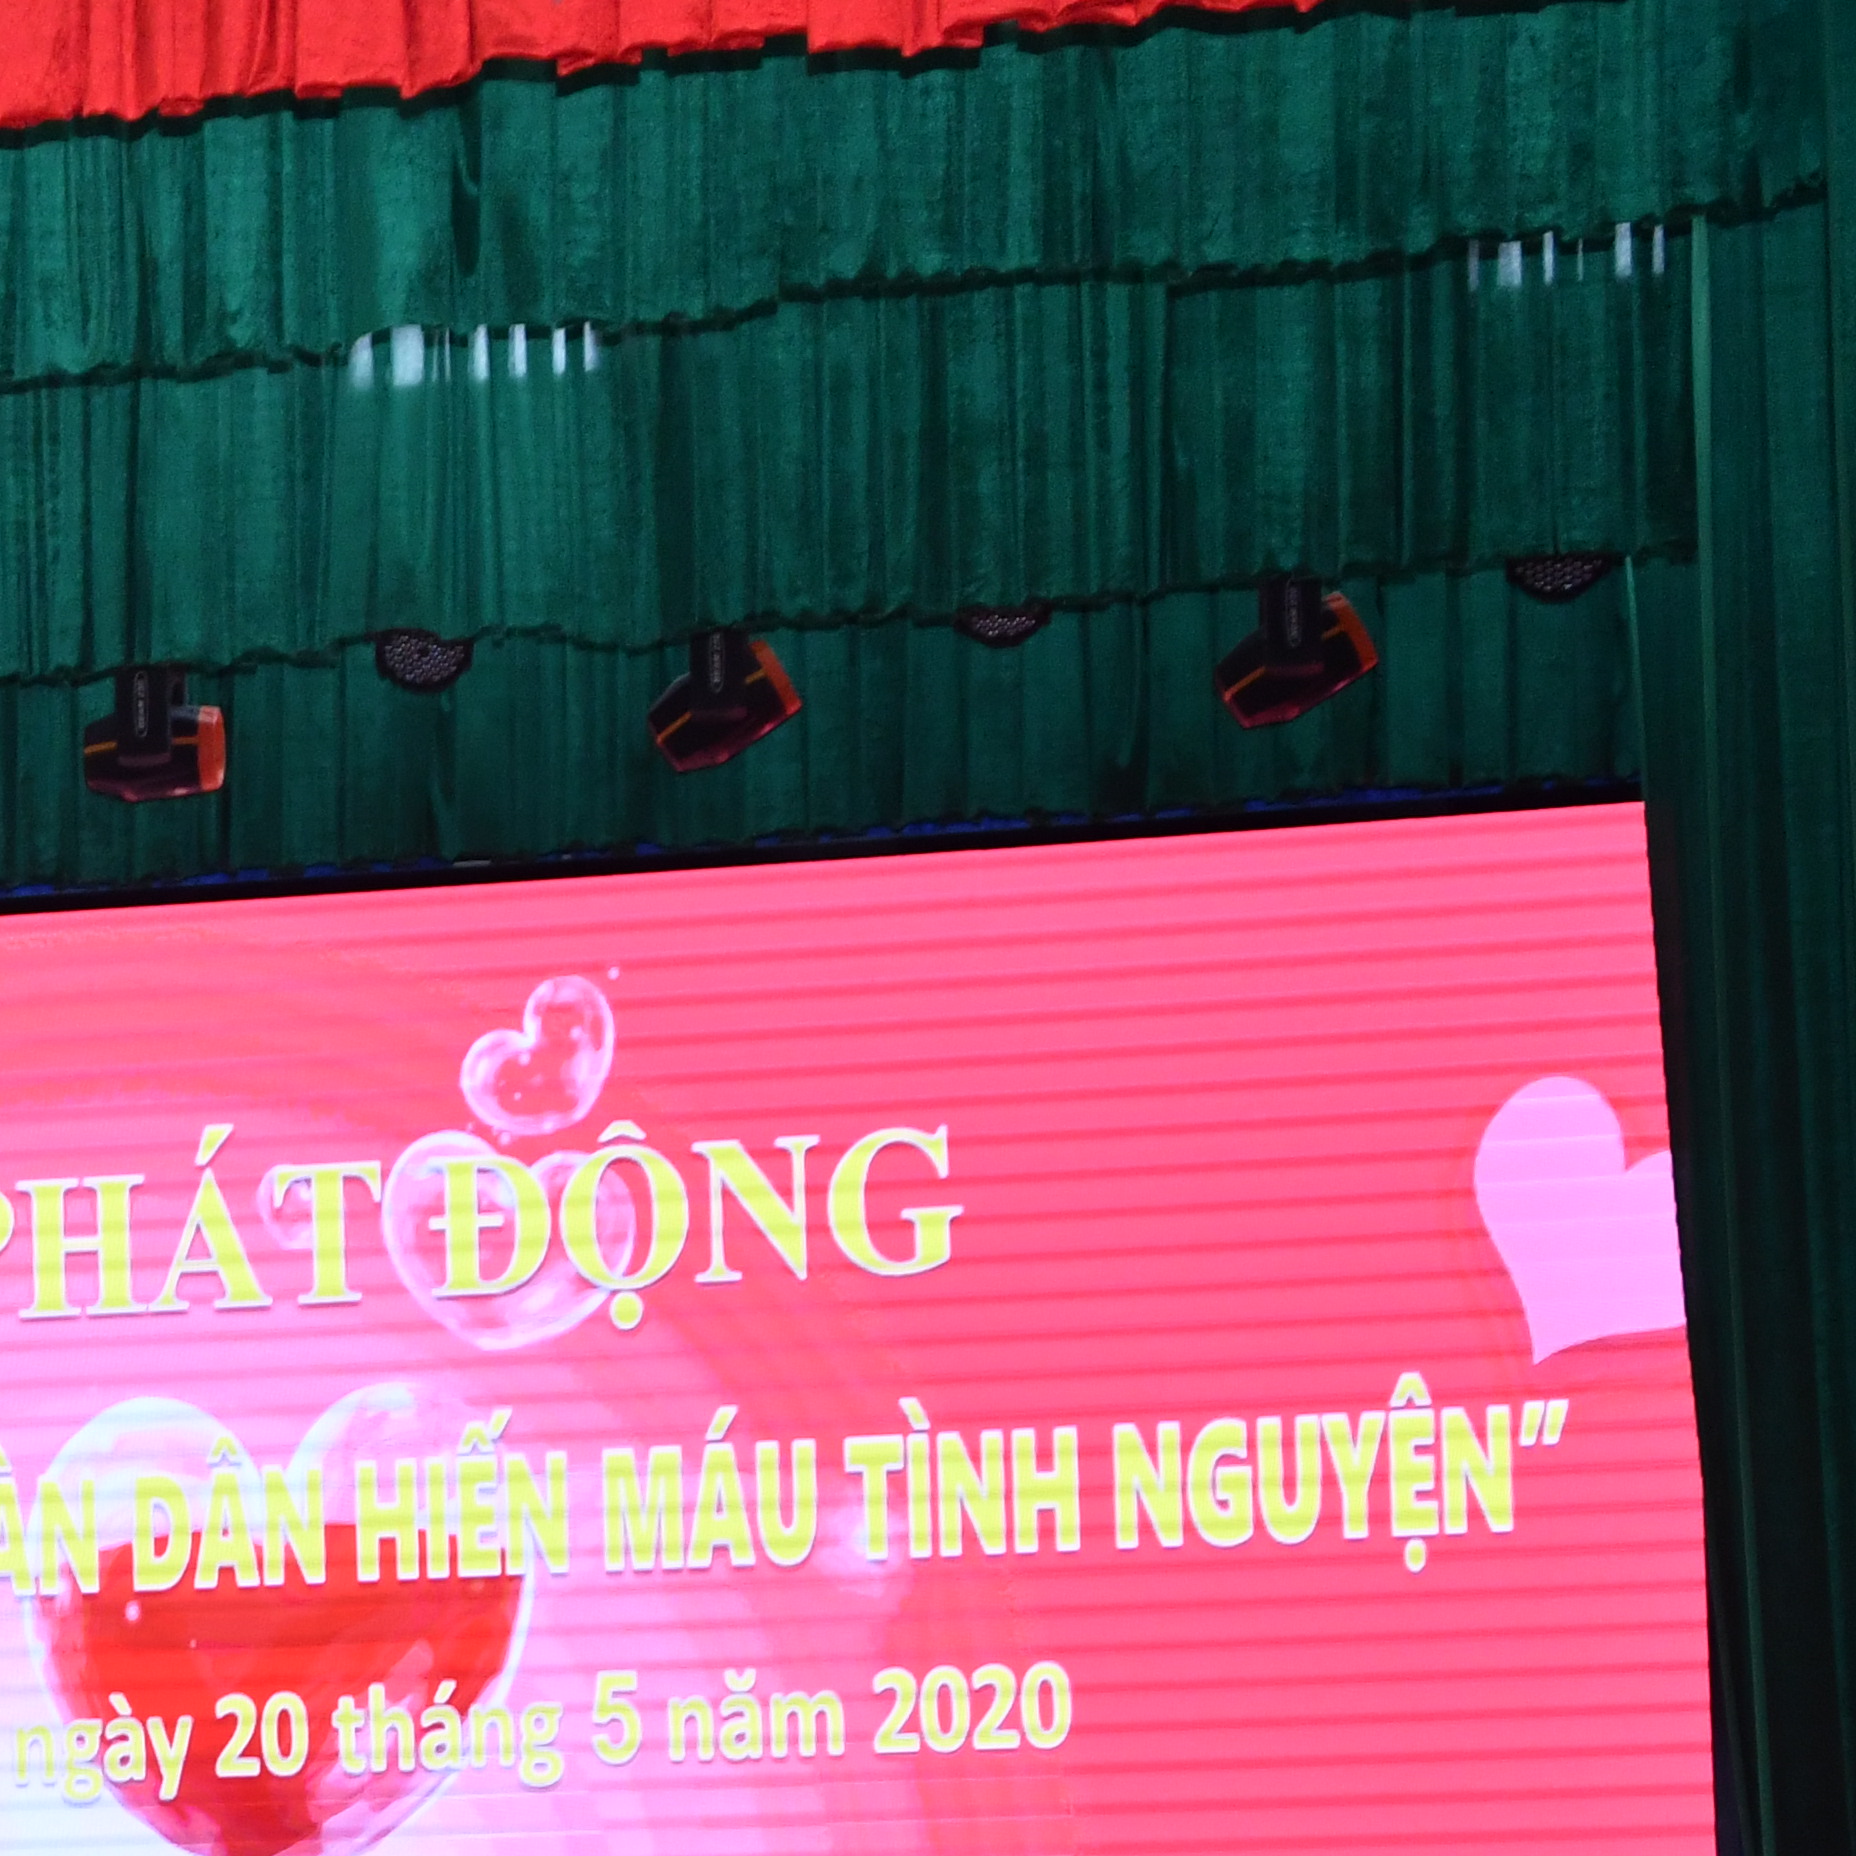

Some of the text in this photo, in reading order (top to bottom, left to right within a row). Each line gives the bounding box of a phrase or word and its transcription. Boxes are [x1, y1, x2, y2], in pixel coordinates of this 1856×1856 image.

[424, 1119, 964, 1331] ĐỘNG
[133, 1436, 326, 1592] DÂN
[355, 1407, 569, 1583] HIẾN
[602, 1404, 818, 1573] MÁU
[844, 1397, 1081, 1561] TÌNH
[15, 1692, 193, 1811] ngày
[215, 1691, 310, 1779] 20
[331, 1680, 564, 1787] tháng
[592, 1670, 641, 1764] 5
[668, 1668, 845, 1763] năm
[872, 1660, 1074, 1756] 2020
